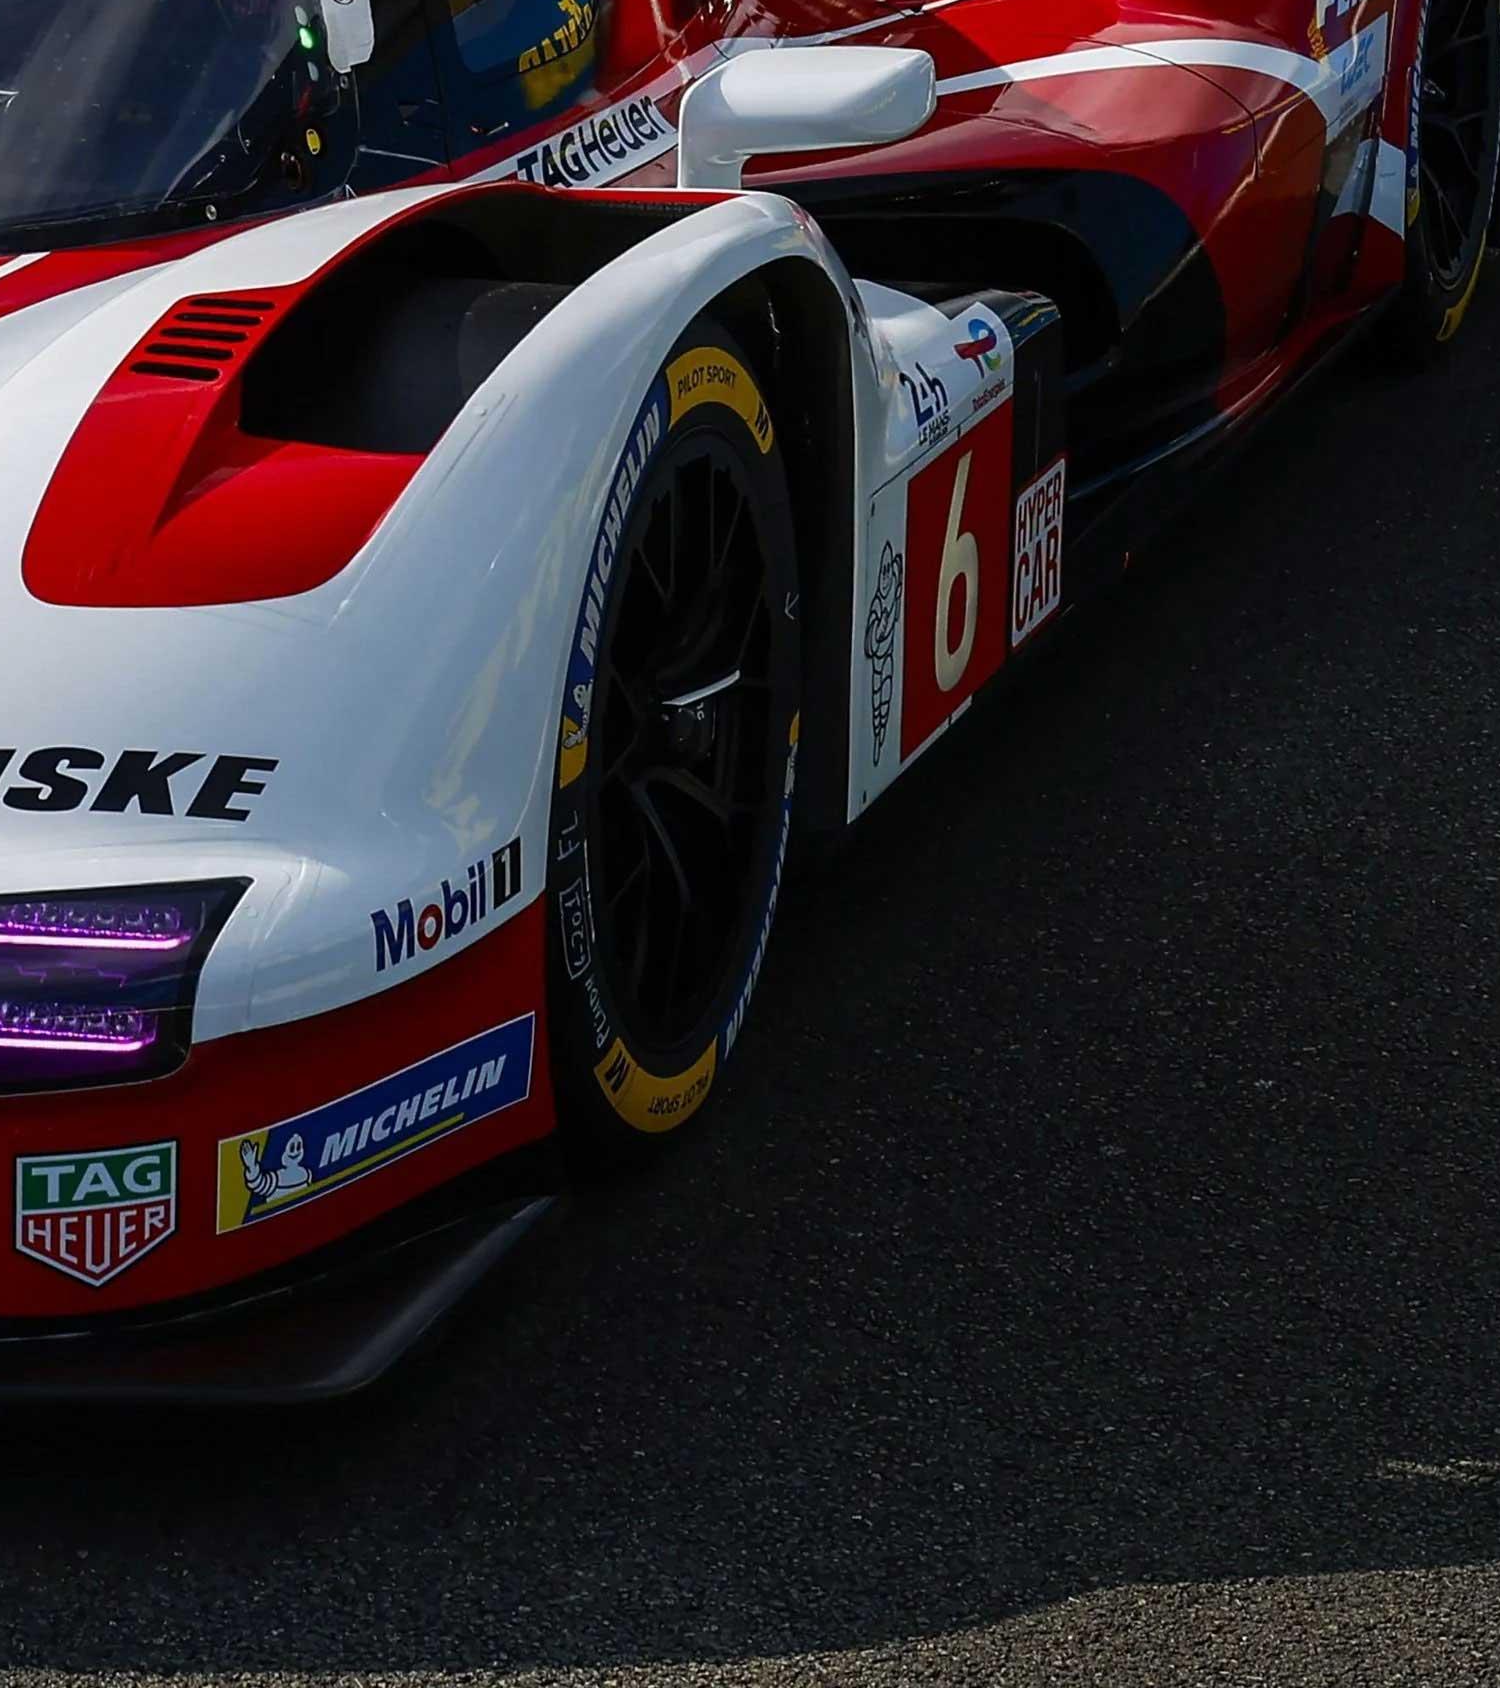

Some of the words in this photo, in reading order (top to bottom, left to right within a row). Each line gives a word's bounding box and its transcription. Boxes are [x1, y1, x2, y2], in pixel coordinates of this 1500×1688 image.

[676, 366, 706, 400] PILOT
[707, 365, 737, 386] SPORT
[578, 400, 662, 667] MICHELIN
[1017, 471, 1062, 554] HYPER
[934, 449, 980, 692] 6
[1015, 525, 1060, 633] CAR
[555, 809, 581, 863] FL
[371, 860, 488, 971] Mobil
[491, 837, 523, 910] 1
[319, 1052, 508, 1169] MICHELIN
[31, 1150, 166, 1202] TAG
[26, 1204, 169, 1278] HEUER
